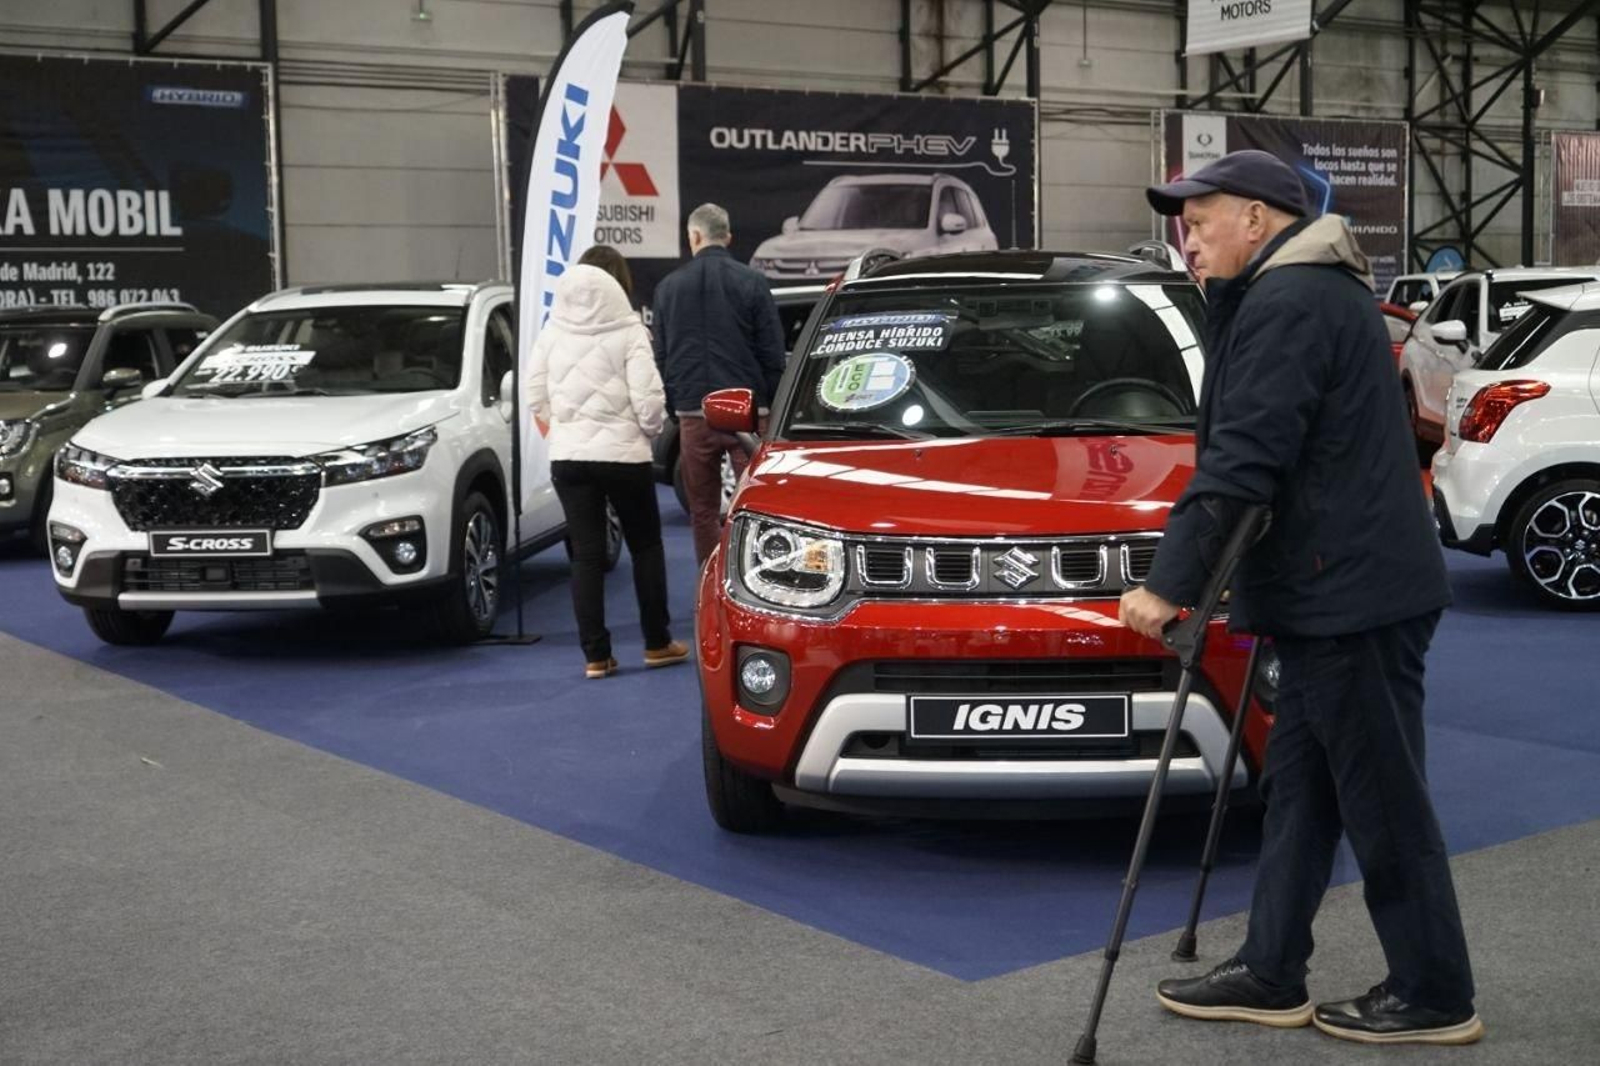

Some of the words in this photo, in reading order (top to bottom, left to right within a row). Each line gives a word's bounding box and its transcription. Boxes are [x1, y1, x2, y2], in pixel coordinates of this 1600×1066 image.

[1221, 0, 1271, 20] MOTORS
[1302, 143, 1330, 156] Todos
[1332, 143, 1346, 157] los
[1348, 145, 1379, 158] sueños
[1381, 148, 1397, 158] son
[1314, 158, 1339, 171] locos
[1341, 159, 1366, 171] hasta
[1368, 162, 1385, 176] que
[1387, 163, 1397, 172] se
[1330, 173, 1357, 185] hacen
[1358, 174, 1397, 186] realidad.
[0, 188, 36, 236] A
[48, 188, 183, 237] MOBIL
[596, 204, 655, 222] SUBISHI
[594, 227, 643, 244] OTORS
[1348, 225, 1398, 234] RANDO
[0, 262, 18, 281] de
[23, 262, 82, 284] Madrid,
[86, 262, 115, 281] 122
[87, 289, 117, 308] 986
[120, 289, 148, 304] 072
[823, 330, 875, 344] PIENSA
[881, 324, 943, 337] HÍBRIDO
[817, 339, 882, 354] CONDUCE
[888, 337, 943, 347] SUZUKI
[848, 363, 865, 391] ECO
[953, 704, 1086, 731] IGNIS
